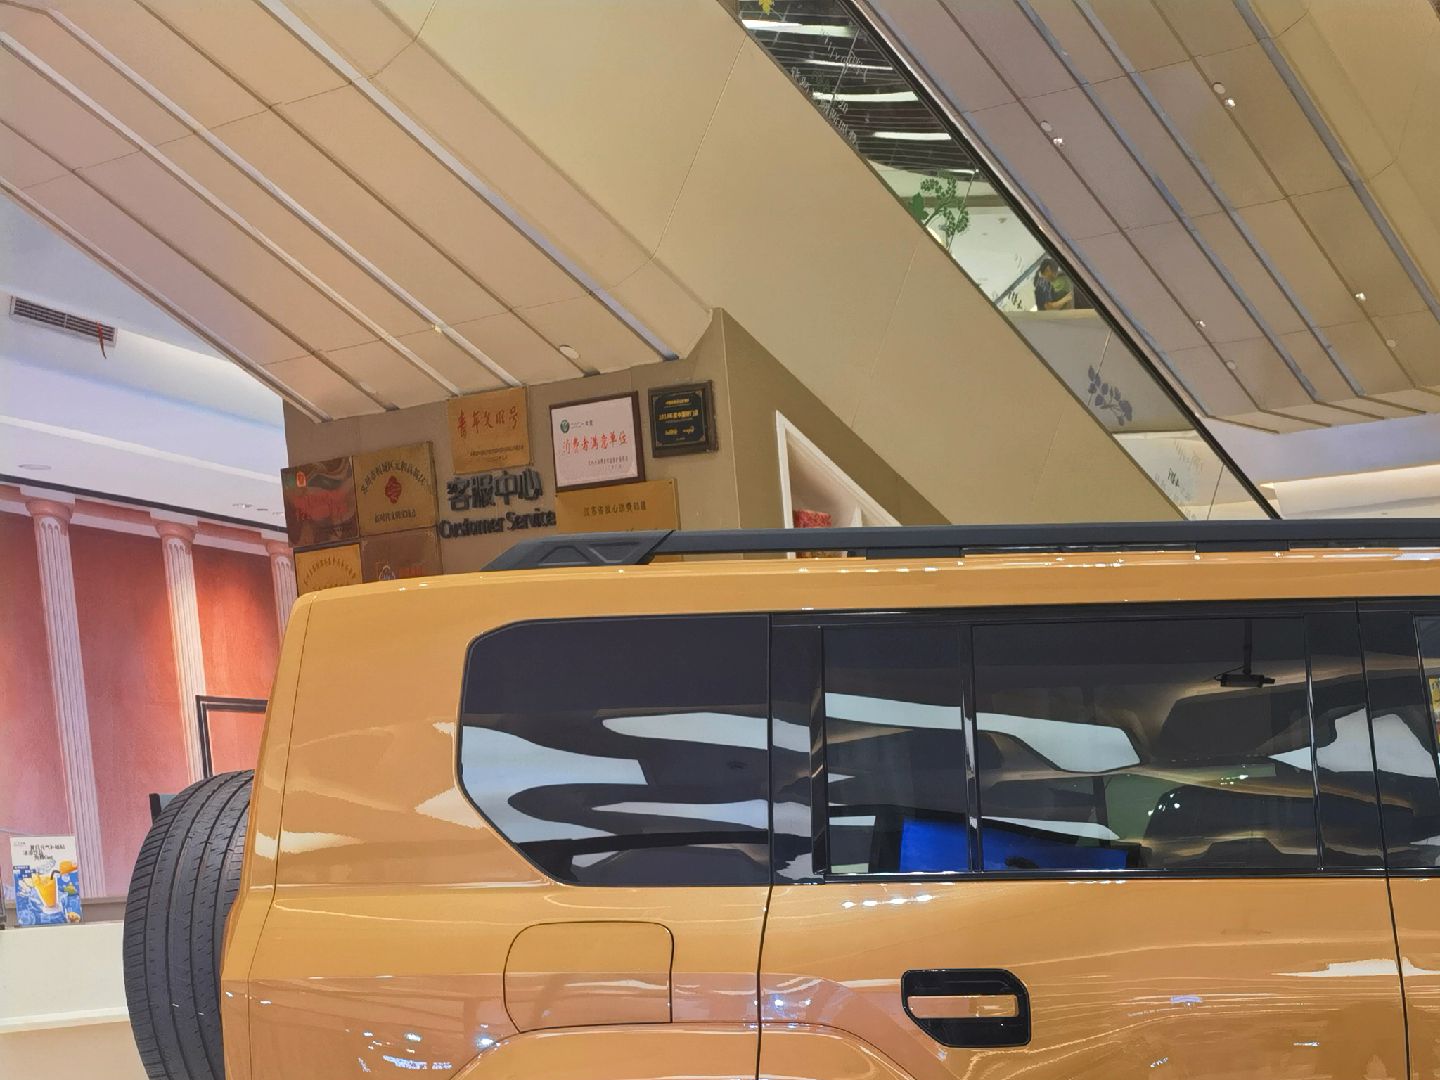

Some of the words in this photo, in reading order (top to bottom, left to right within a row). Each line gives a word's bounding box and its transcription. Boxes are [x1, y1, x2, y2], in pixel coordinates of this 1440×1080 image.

[446, 468, 543, 512] 客服中心
[438, 516, 505, 540] Customer
[505, 507, 557, 532] Service
